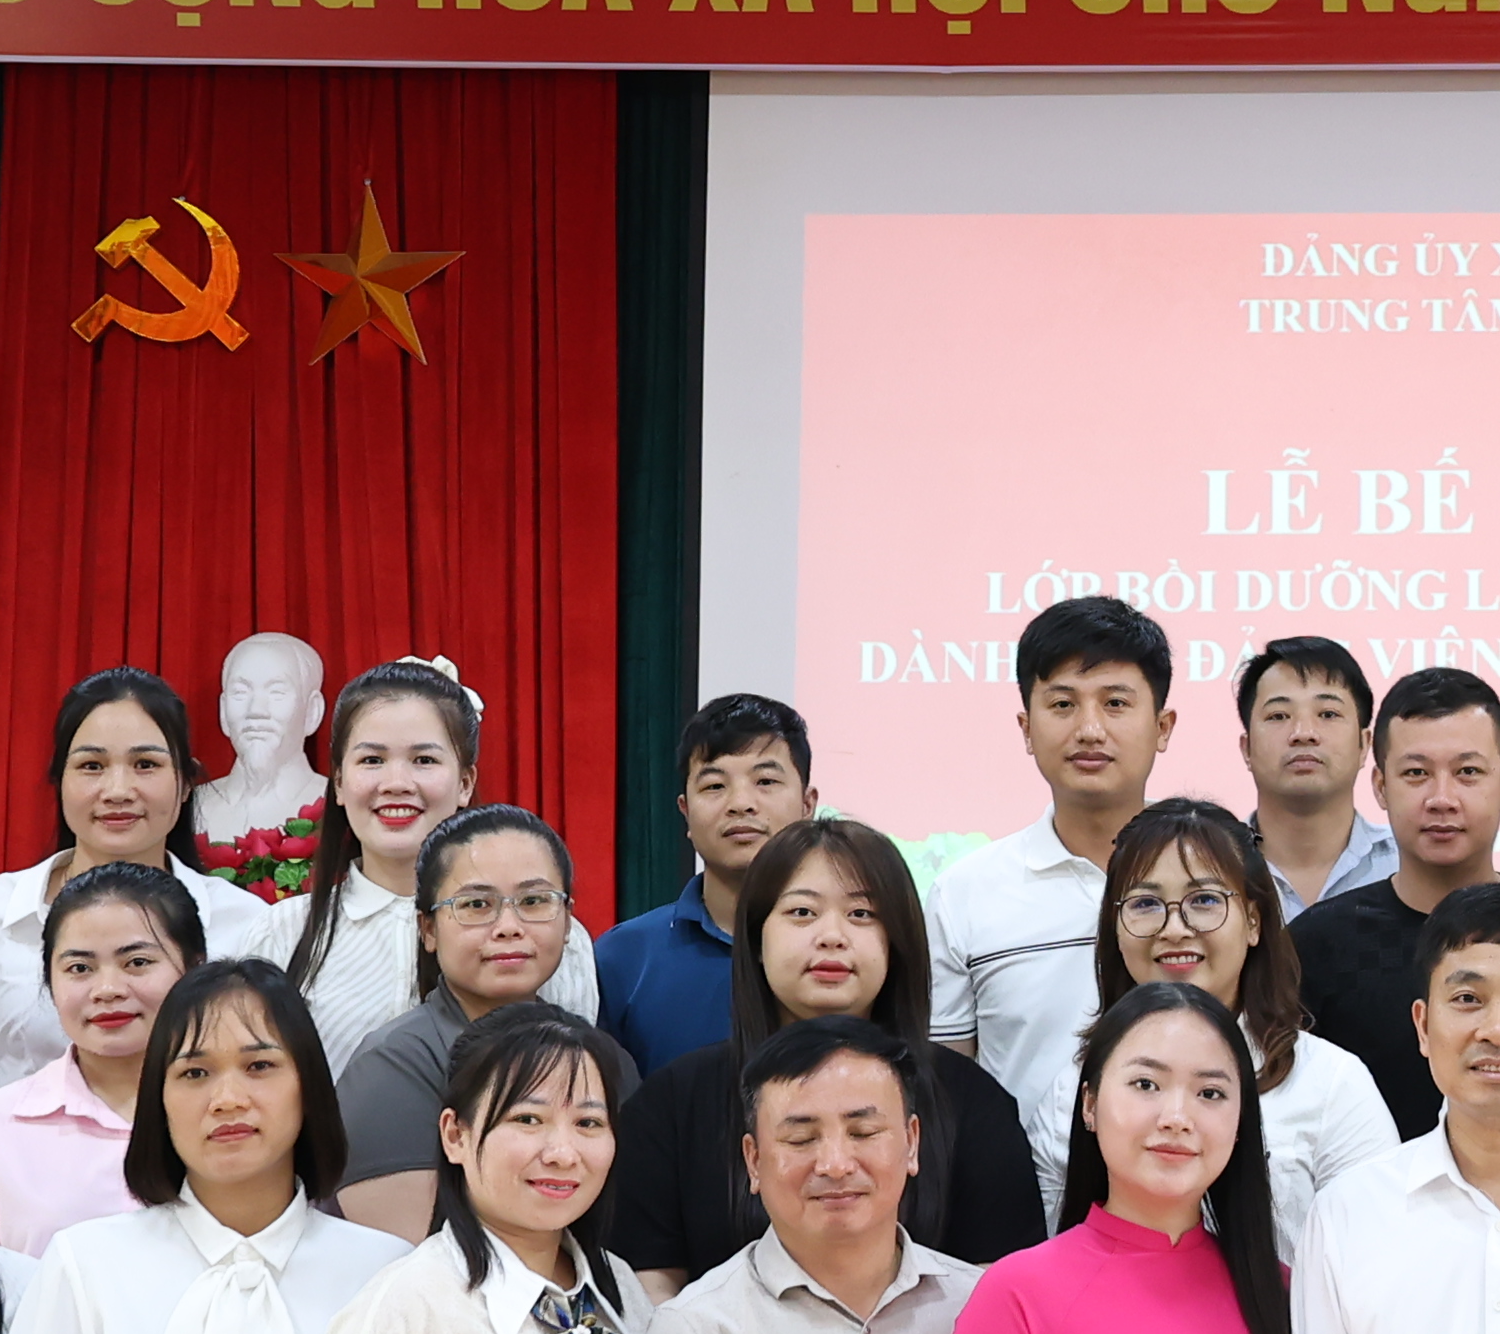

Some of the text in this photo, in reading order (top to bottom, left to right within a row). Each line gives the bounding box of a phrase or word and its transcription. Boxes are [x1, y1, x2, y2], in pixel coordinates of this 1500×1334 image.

[1261, 233, 1400, 277] ĐẢNG
[1414, 233, 1480, 276] ỦY
[1239, 299, 1411, 334] TRUNG
[1201, 447, 1325, 535] LỄ
[1353, 446, 1476, 535] BẾ
[985, 559, 1103, 615] LỚP
[1114, 558, 1218, 614] BỒI
[1234, 559, 1450, 613] DƯỠNG
[858, 629, 1019, 683] DÀNH
